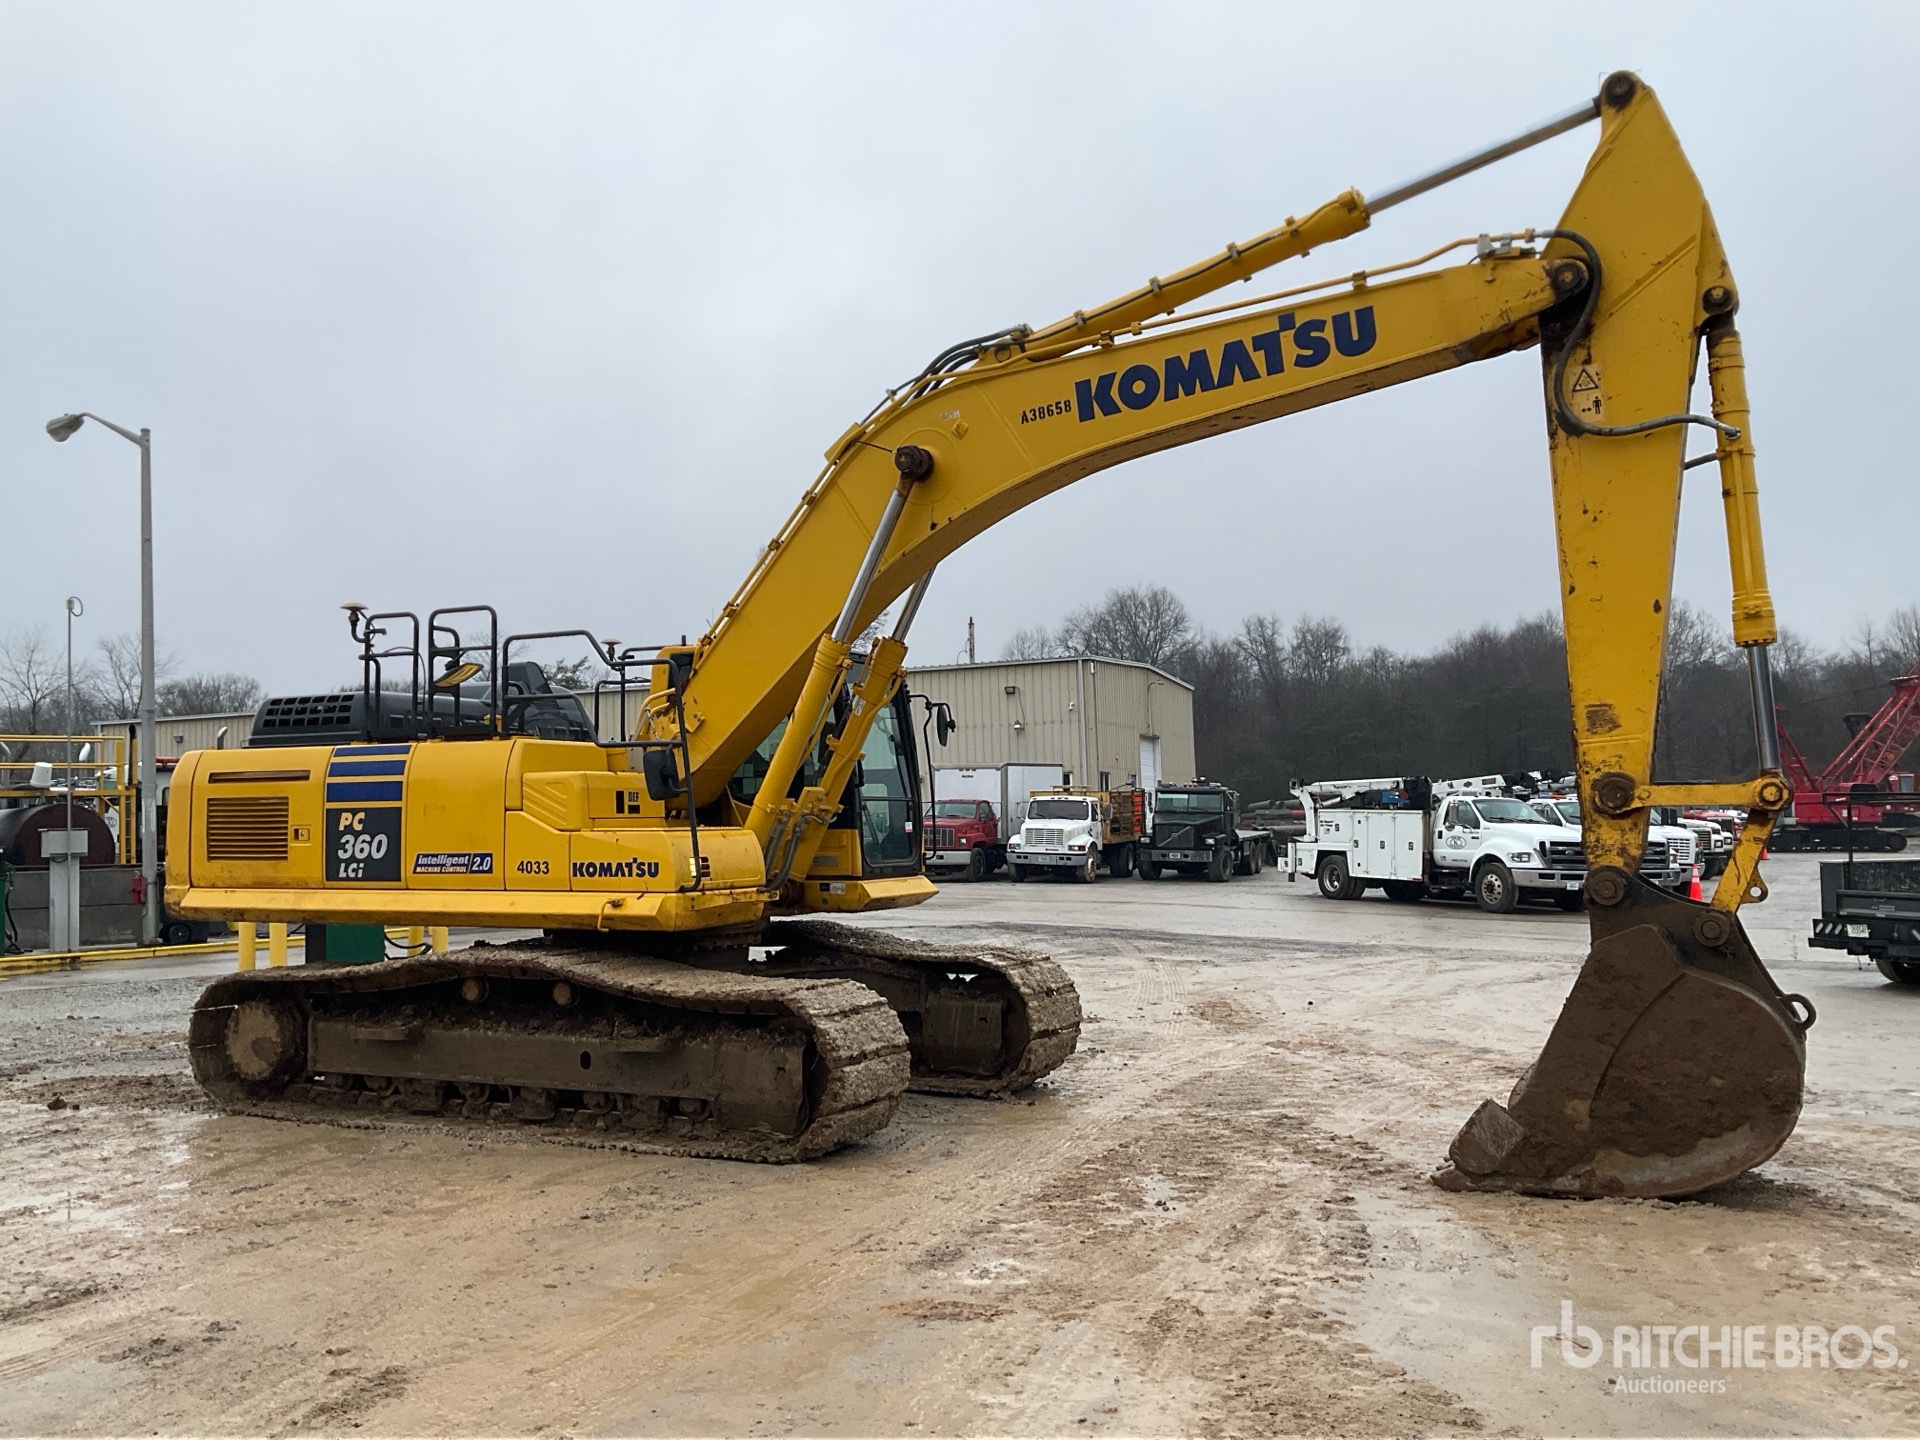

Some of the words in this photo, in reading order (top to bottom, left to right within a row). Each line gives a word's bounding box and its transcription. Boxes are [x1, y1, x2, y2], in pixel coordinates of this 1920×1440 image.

[1075, 306, 1377, 422] KOMATSU
[1020, 399, 1072, 424] A38658
[628, 791, 640, 803] DEF
[338, 811, 366, 831] PC
[337, 833, 388, 859] 360
[338, 862, 364, 878] LCi
[418, 854, 469, 866] intelligent
[471, 856, 491, 871] 2.0
[516, 860, 550, 874] 4033
[572, 857, 659, 877] KOMATSU
